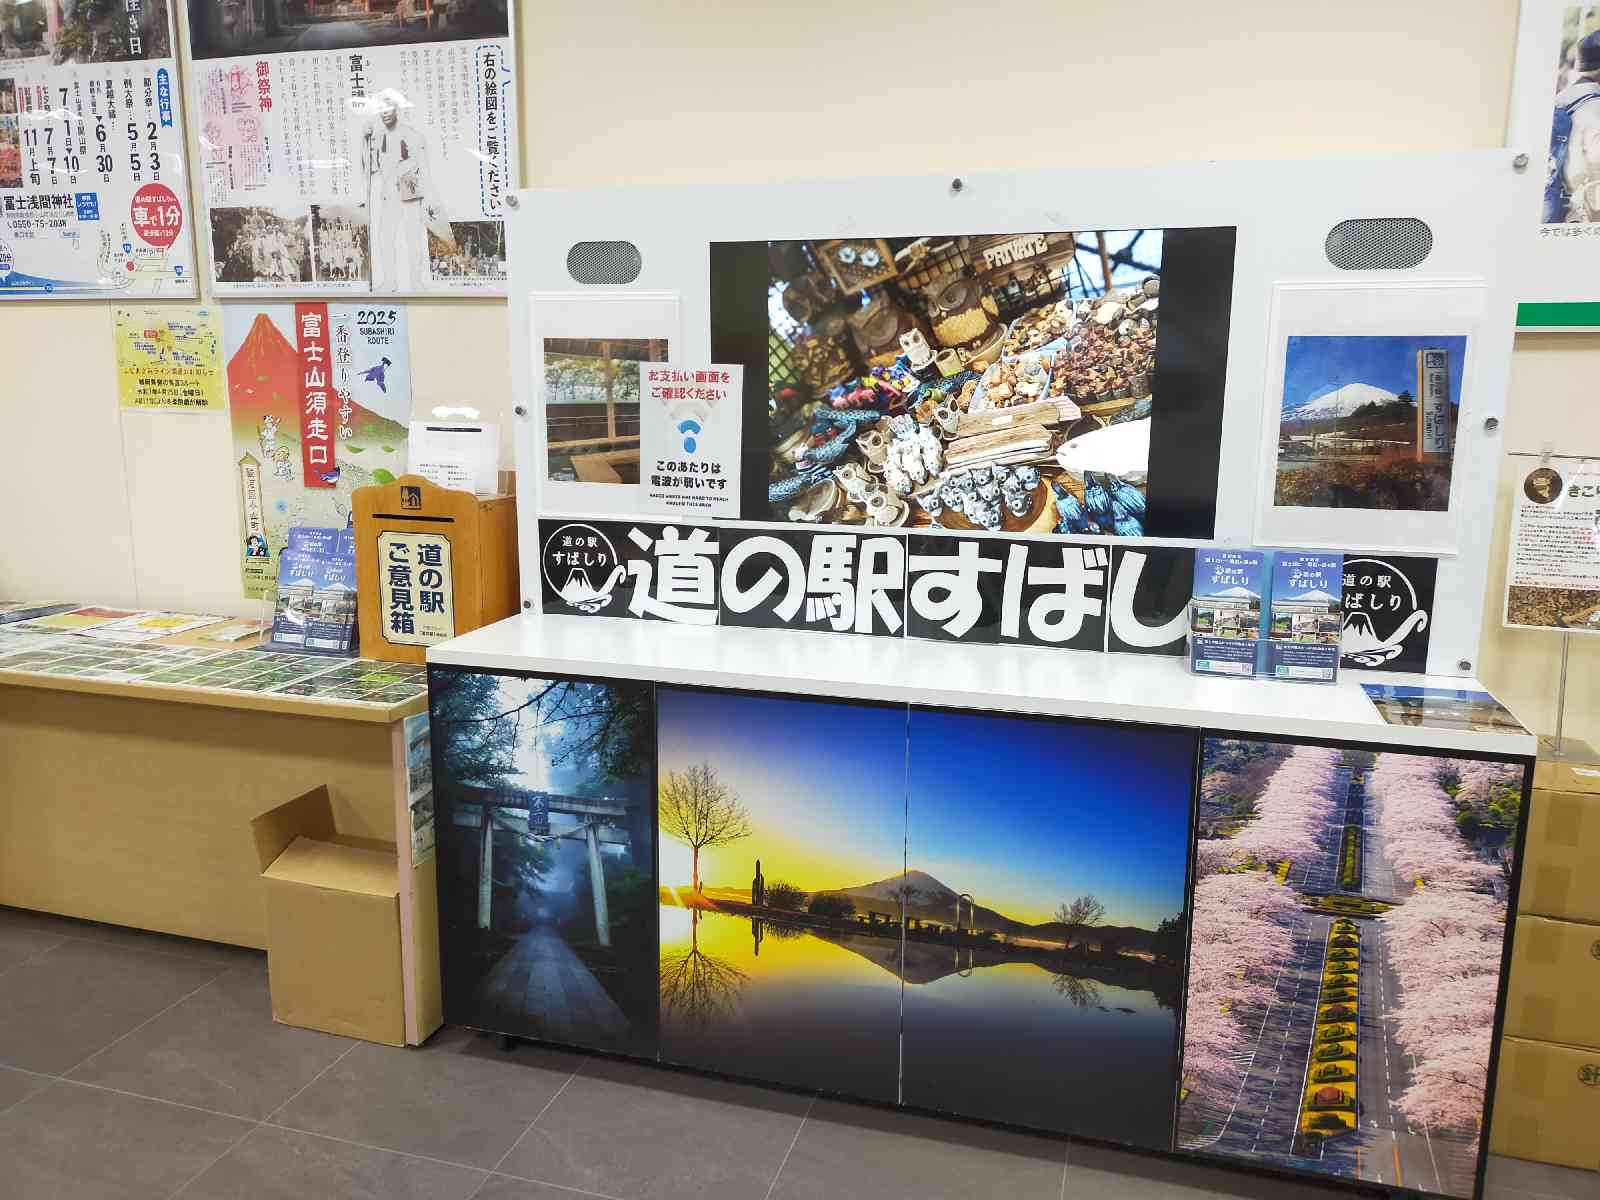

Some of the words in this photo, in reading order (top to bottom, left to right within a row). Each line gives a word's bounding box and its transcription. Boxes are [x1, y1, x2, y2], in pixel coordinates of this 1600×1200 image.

[484, 52, 501, 210] 右の絵図をご覧ください
[96, 124, 113, 182] 6月30日
[128, 123, 140, 181] 5月5日
[147, 122, 160, 181] 2月3日
[133, 205, 181, 227] 車で1分
[983, 234, 1049, 269] PRIVATE
[357, 310, 397, 325] 2025
[359, 327, 395, 336] SUBASHIRI
[367, 336, 389, 345] ROUTE
[331, 312, 353, 441] 一番登りやすい
[648, 370, 731, 384] お支払い画面を
[301, 312, 329, 464] 富士山須走口
[651, 386, 727, 400] ご確認ください
[656, 460, 721, 474] このあたりは
[651, 475, 727, 490] 電波が弱いです
[562, 535, 598, 549] 道の駅
[552, 550, 607, 567] すばしり
[417, 543, 446, 613] 道の駅
[1289, 579, 1328, 589] すばしり
[1343, 573, 1392, 589] 道の駅
[387, 542, 415, 635] ご意見箱
[1344, 593, 1401, 612] ばしり
